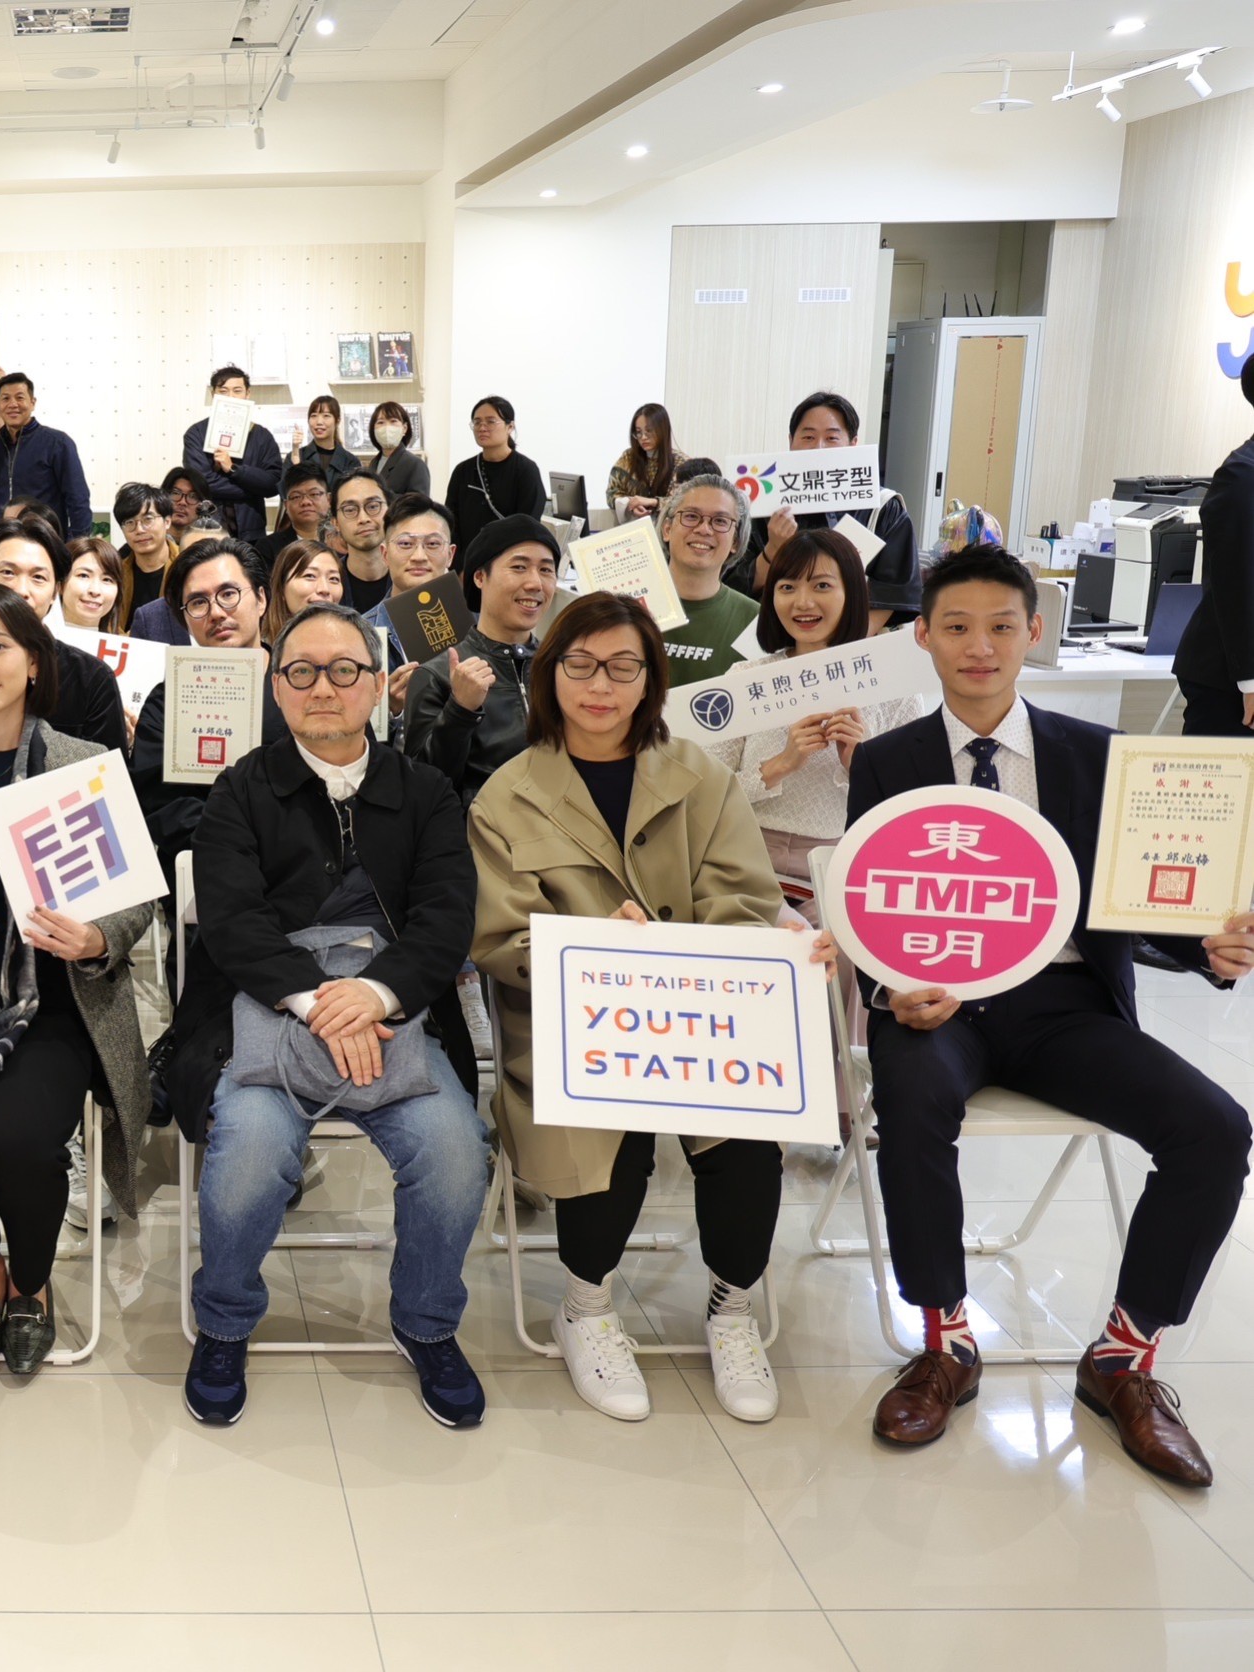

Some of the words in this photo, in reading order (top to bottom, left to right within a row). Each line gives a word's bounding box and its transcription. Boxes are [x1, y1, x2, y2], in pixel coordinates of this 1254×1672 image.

[779, 466, 873, 493] 文鼎字型
[780, 492, 829, 505] ARPHIC
[832, 489, 873, 501] TYPES
[432, 637, 458, 653] INTAO
[745, 653, 873, 701] 東煦色研所
[844, 677, 879, 694] LAB
[908, 820, 1001, 862] 東
[871, 874, 1030, 917] TMPI
[902, 929, 985, 969] 明
[582, 971, 633, 987] NEW
[641, 975, 714, 992] TAIPEI
[722, 980, 775, 995] CITY
[583, 1005, 735, 1039] YOUTH
[584, 1049, 784, 1087] STATION
